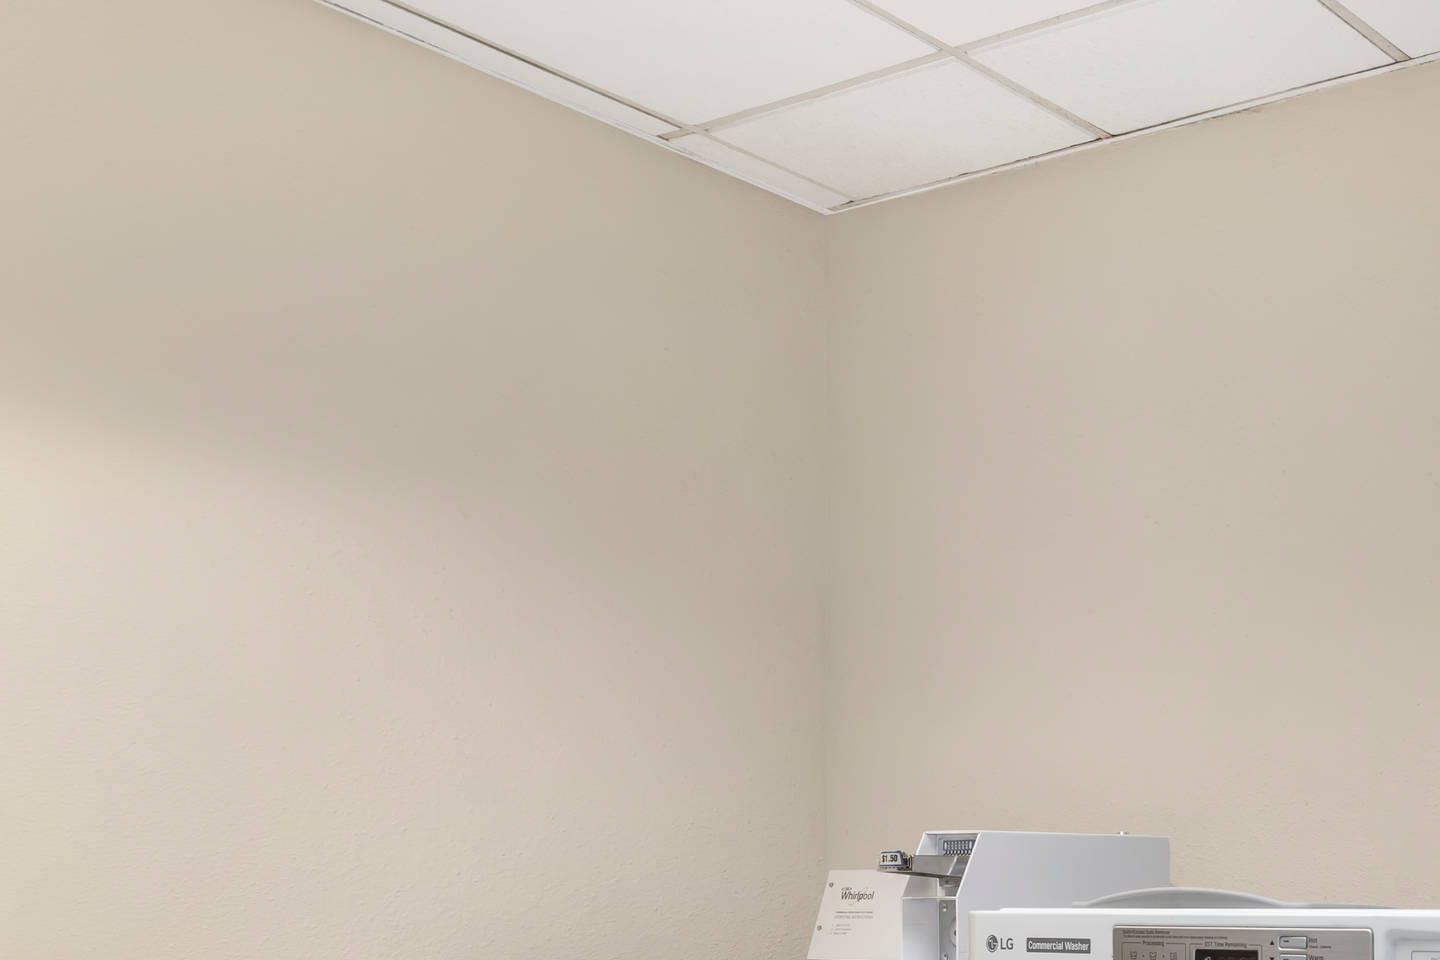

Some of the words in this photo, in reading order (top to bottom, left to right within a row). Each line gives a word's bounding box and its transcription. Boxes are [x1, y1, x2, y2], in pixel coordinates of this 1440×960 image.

[881, 854, 898, 863] $1.50
[840, 889, 875, 902] Whirlpool
[1028, 940, 1064, 951] Commercial
[1064, 941, 1090, 952] Washer
